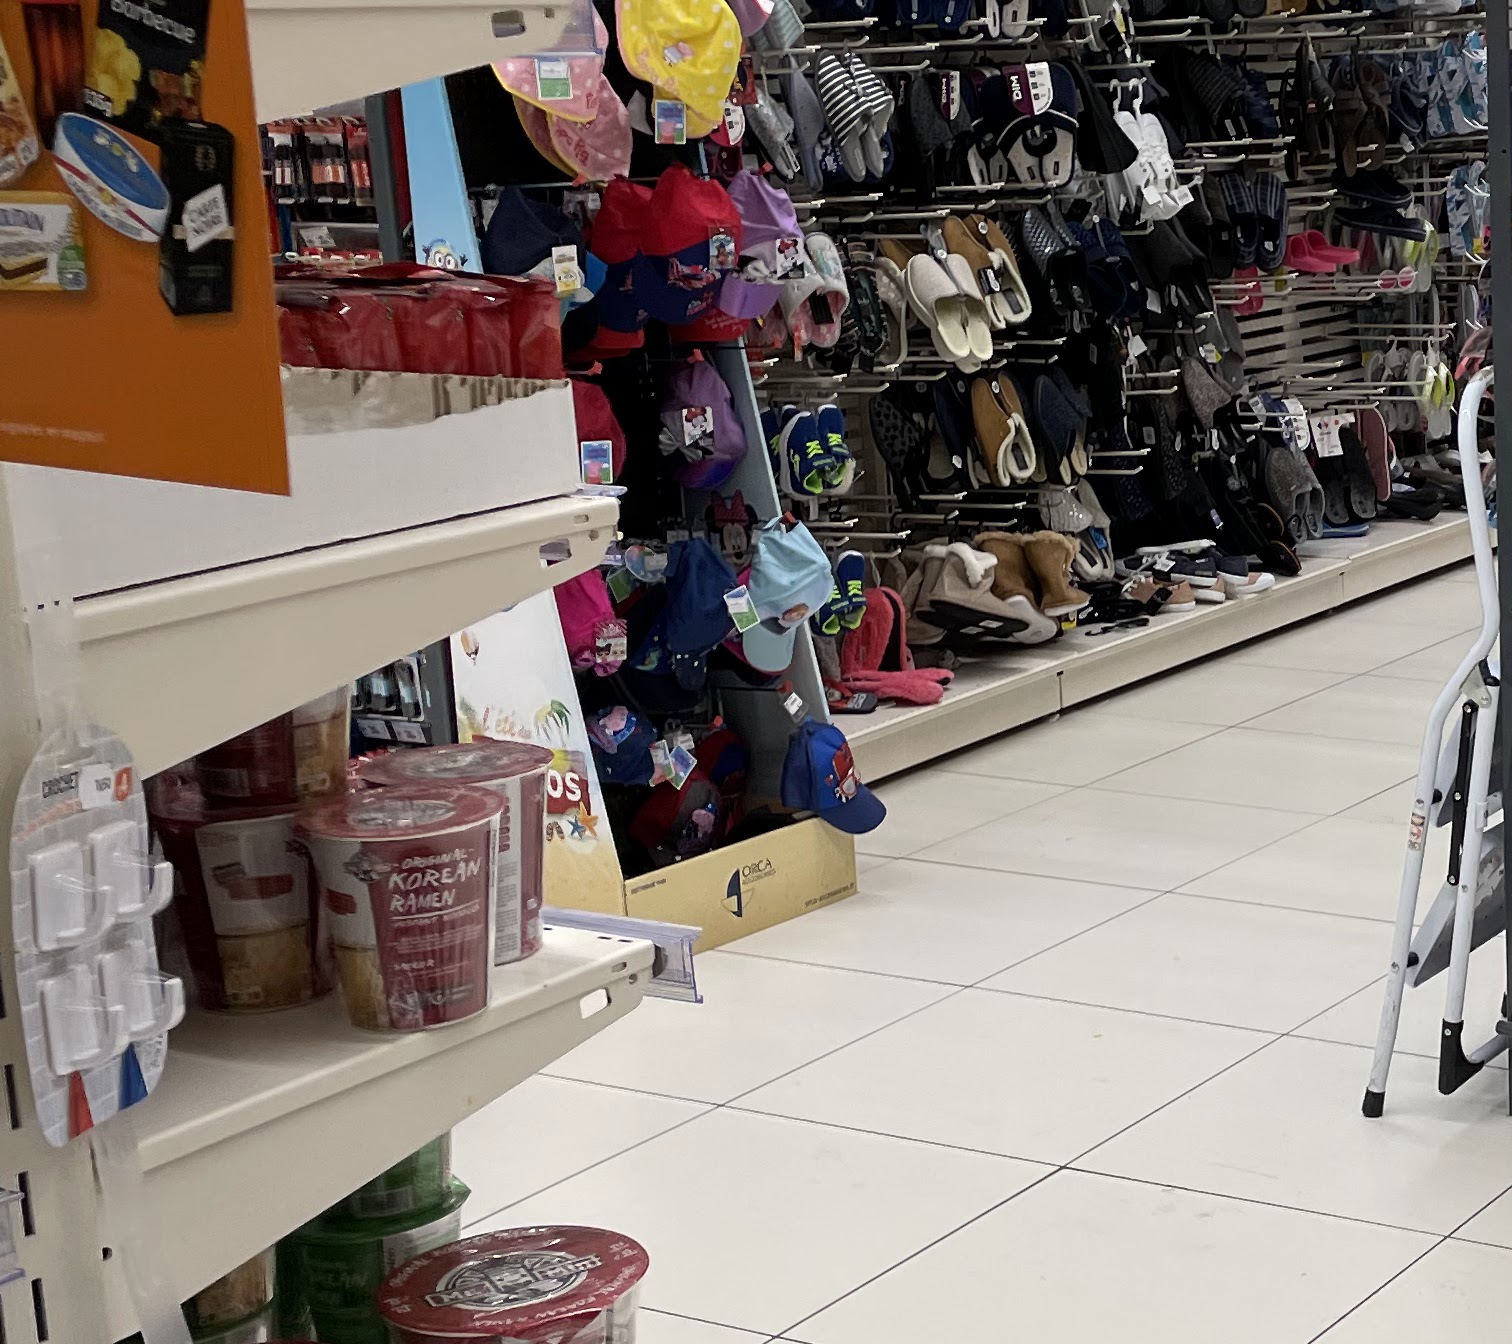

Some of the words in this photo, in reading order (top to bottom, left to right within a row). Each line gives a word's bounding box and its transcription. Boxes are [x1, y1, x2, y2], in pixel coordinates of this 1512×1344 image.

[1009, 75, 1023, 101] DIM
[388, 858, 481, 891] KOREAN
[742, 858, 773, 877] ORCA
[390, 888, 456, 913] RAMEN
